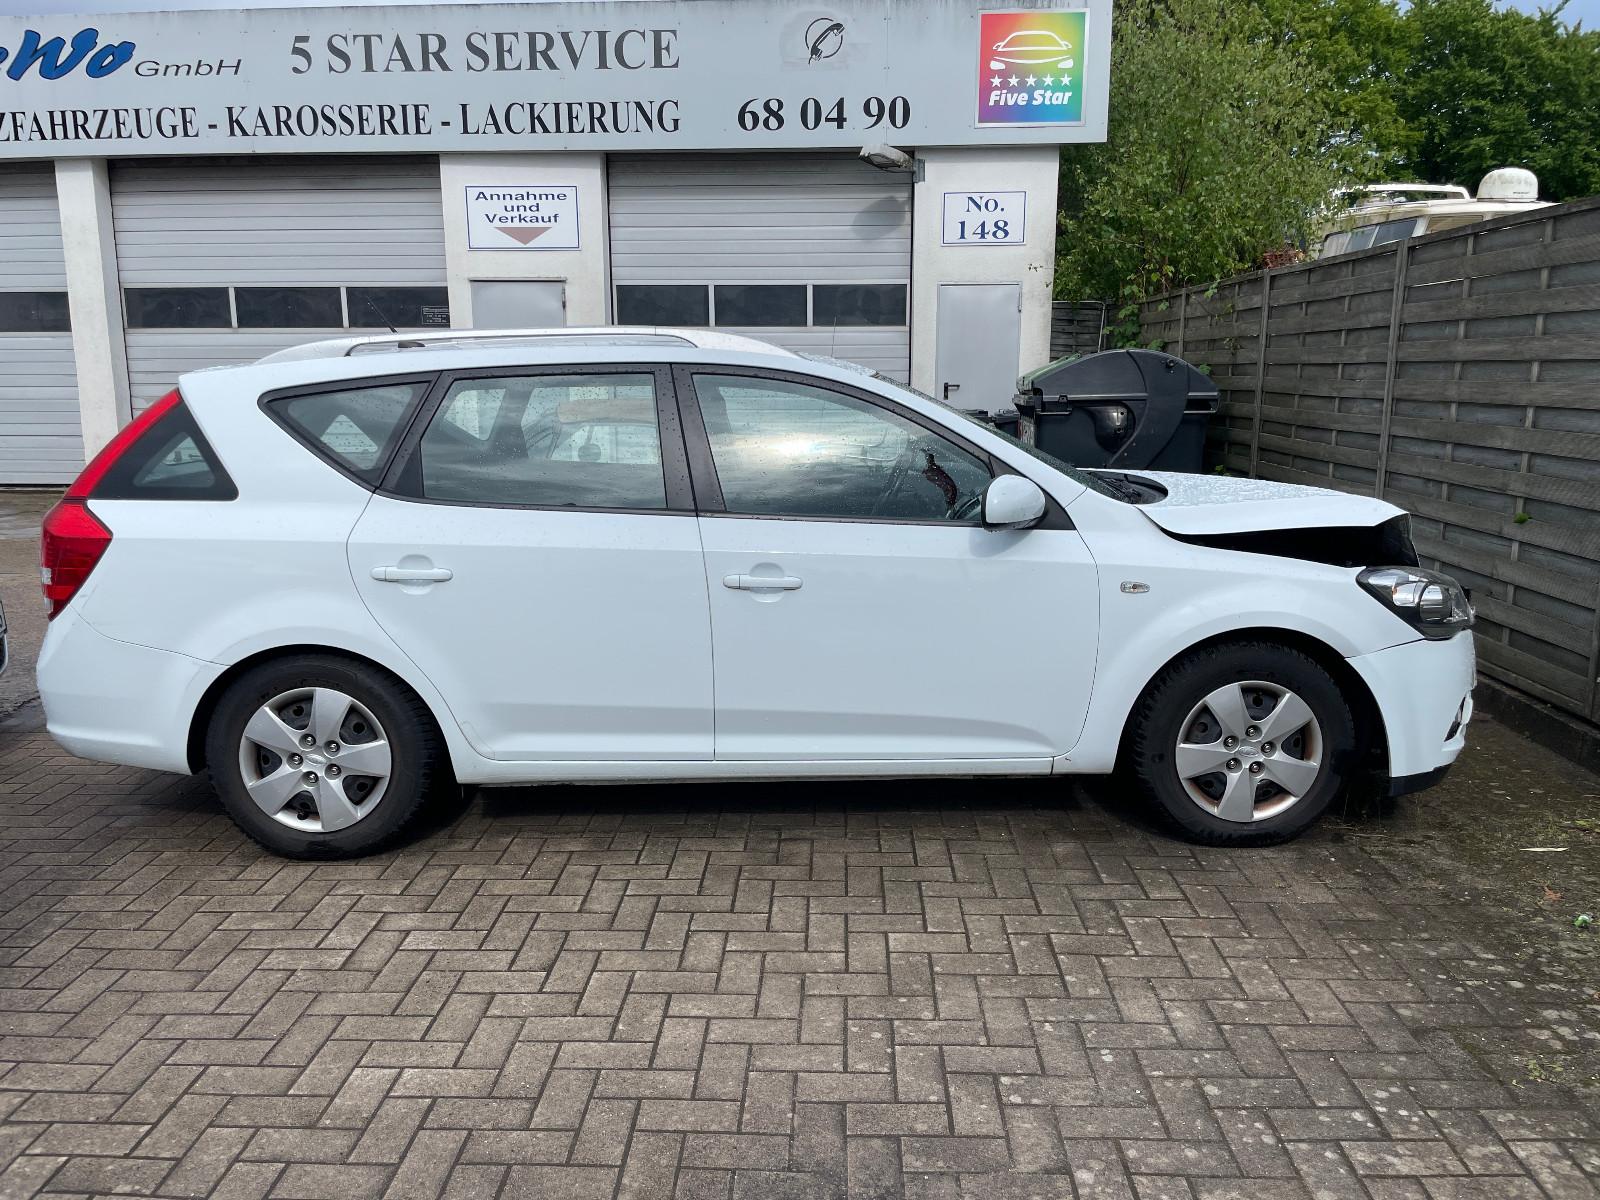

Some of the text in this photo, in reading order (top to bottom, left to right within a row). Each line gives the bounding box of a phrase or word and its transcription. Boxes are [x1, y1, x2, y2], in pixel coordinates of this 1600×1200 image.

[291, 29, 680, 74] 5 STAR SERVICE
[134, 58, 242, 77] GmbH
[989, 89, 1073, 107] Five Star
[225, 103, 432, 138] KAROSSERIE
[459, 99, 681, 136] LACKIERUNG
[737, 95, 911, 131] 68 04 90
[475, 191, 568, 201] Annahme
[966, 196, 1005, 213] No.
[504, 202, 541, 213] und
[485, 213, 560, 224] Verkauf
[957, 219, 1010, 240] 148
